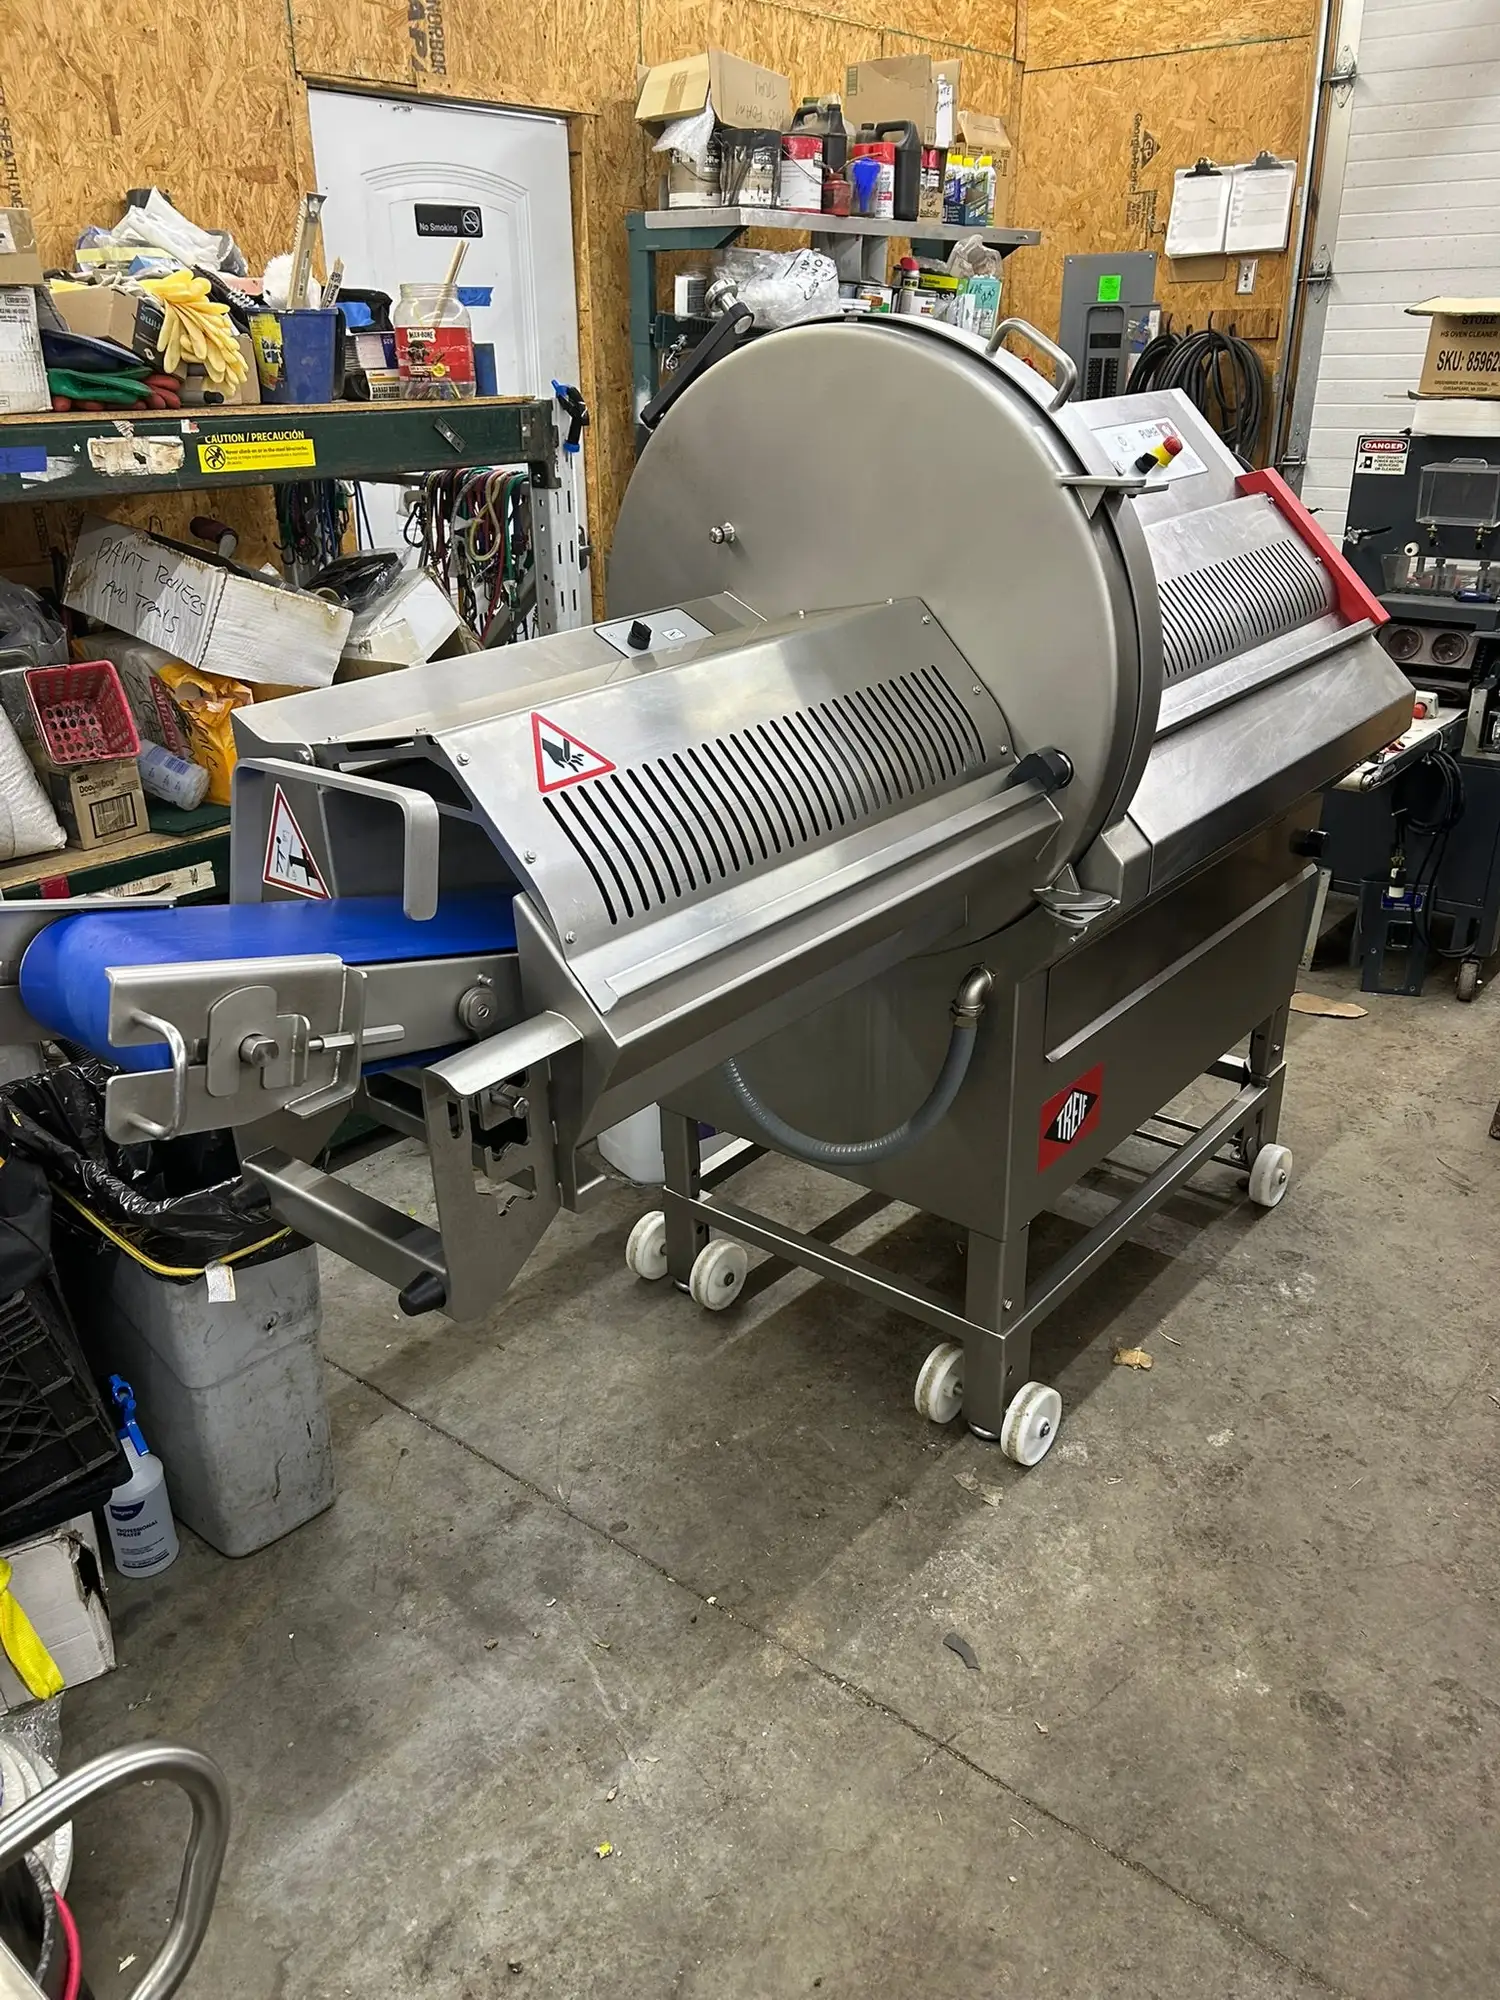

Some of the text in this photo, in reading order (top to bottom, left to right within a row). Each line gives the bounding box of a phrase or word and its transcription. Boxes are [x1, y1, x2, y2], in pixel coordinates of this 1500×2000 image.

[1143, 138, 1154, 160] GP
[419, 222, 458, 234] No Smoking
[1462, 315, 1497, 325] STORE
[1450, 330, 1467, 338] OVEN
[1468, 330, 1499, 338] CLEANER
[1437, 350, 1500, 372] SKU: 85962
[204, 429, 305, 444] CAUTION / PRECAUCIÓN
[1364, 442, 1404, 450] DANGER
[1056, 1091, 1088, 1141] TREIF
[115, 1519, 158, 1533] PROFESSIONAL
